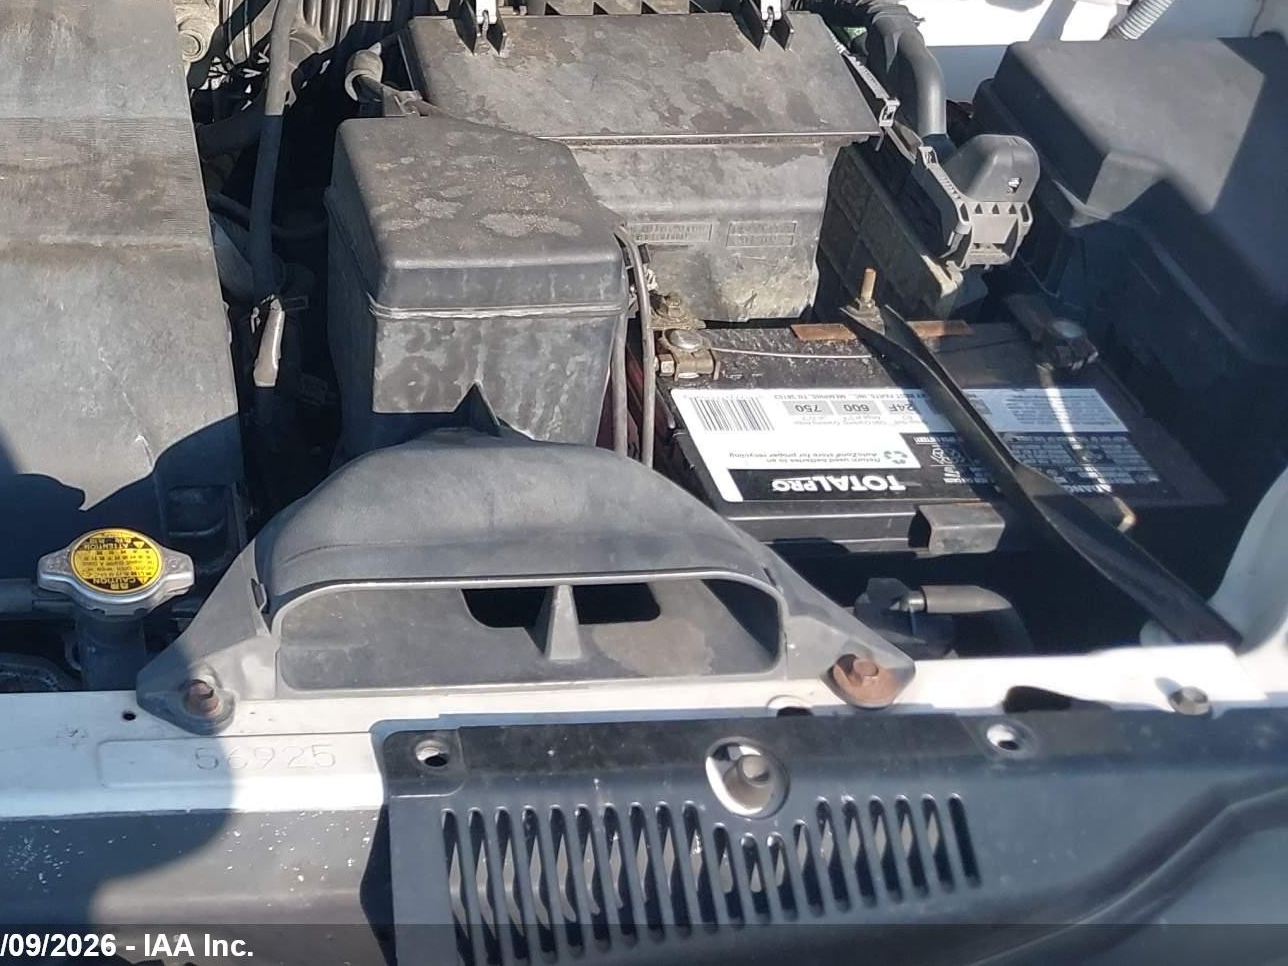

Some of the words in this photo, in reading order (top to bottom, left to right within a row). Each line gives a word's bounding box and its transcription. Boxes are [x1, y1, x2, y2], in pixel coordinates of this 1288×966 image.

[794, 403, 823, 413] 750
[843, 403, 871, 413] 600
[772, 475, 906, 492] TOTALPRO
[195, 744, 336, 770] 56925
